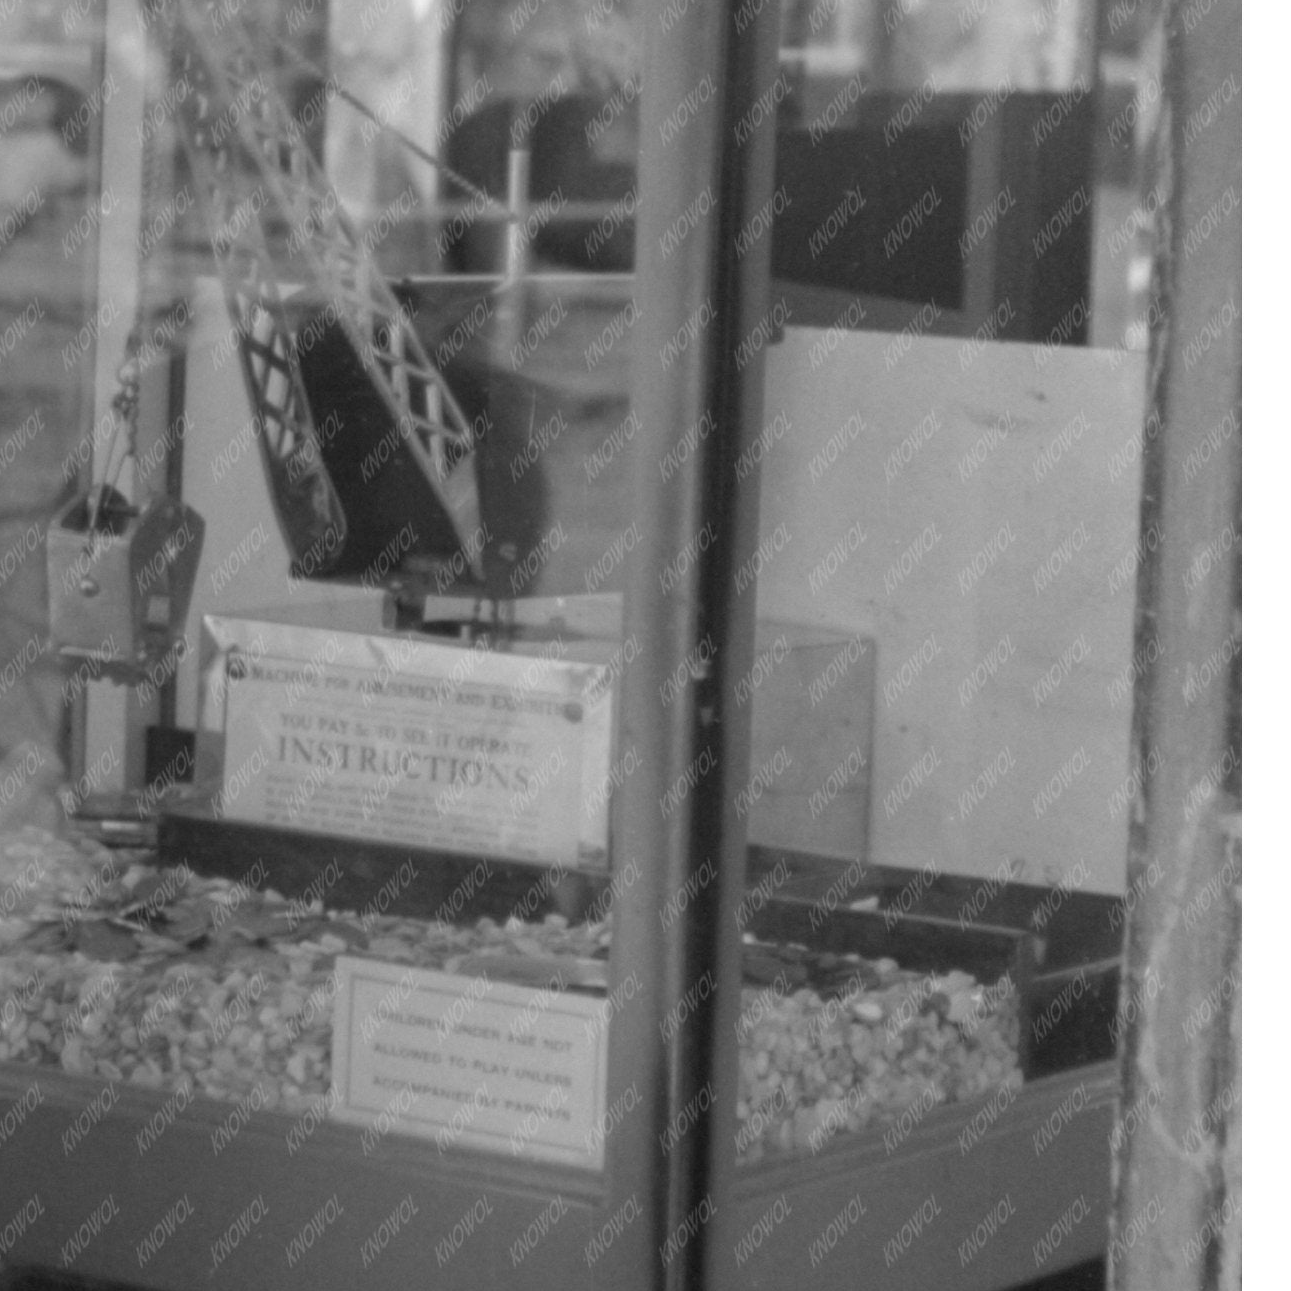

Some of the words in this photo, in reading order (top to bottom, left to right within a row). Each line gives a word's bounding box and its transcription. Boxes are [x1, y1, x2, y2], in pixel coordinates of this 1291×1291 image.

[251, 665, 318, 688] MACHINE
[356, 679, 451, 702] AMUSEMENT
[279, 712, 313, 731] YOU
[317, 717, 350, 736] PAY
[377, 724, 398, 742] TO
[402, 727, 430, 745] SEE
[435, 732, 451, 749] IT
[456, 734, 532, 757] OPERATE
[277, 734, 531, 794] INSTRUCTIONS
[374, 1009, 446, 1032] CHILDREN
[372, 1042, 443, 1066] ALLOWED
[471, 1059, 510, 1077] PLAY
